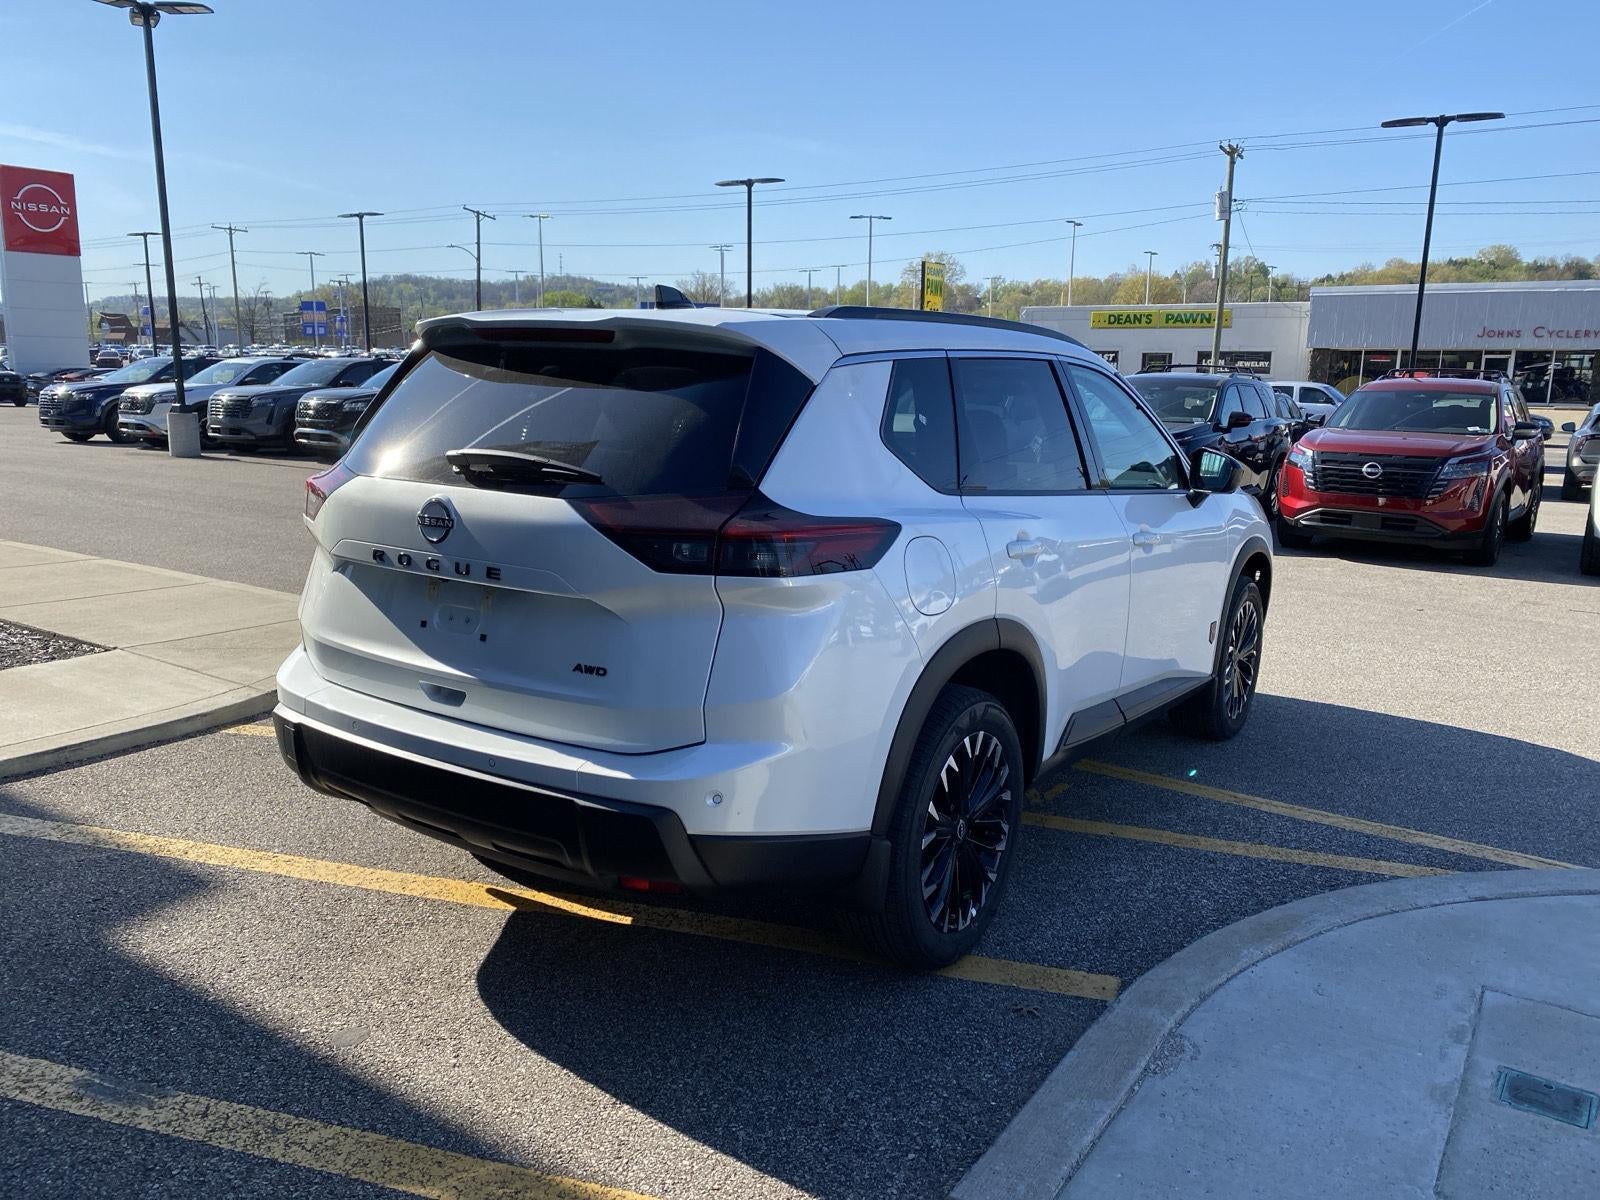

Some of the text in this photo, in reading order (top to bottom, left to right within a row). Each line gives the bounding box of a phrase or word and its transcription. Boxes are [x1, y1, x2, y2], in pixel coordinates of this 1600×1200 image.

[10, 201, 70, 215] NISSAN
[1235, 360, 1270, 368] JEWELRY
[372, 548, 502, 581] ROGUE
[572, 662, 608, 677] AWD
